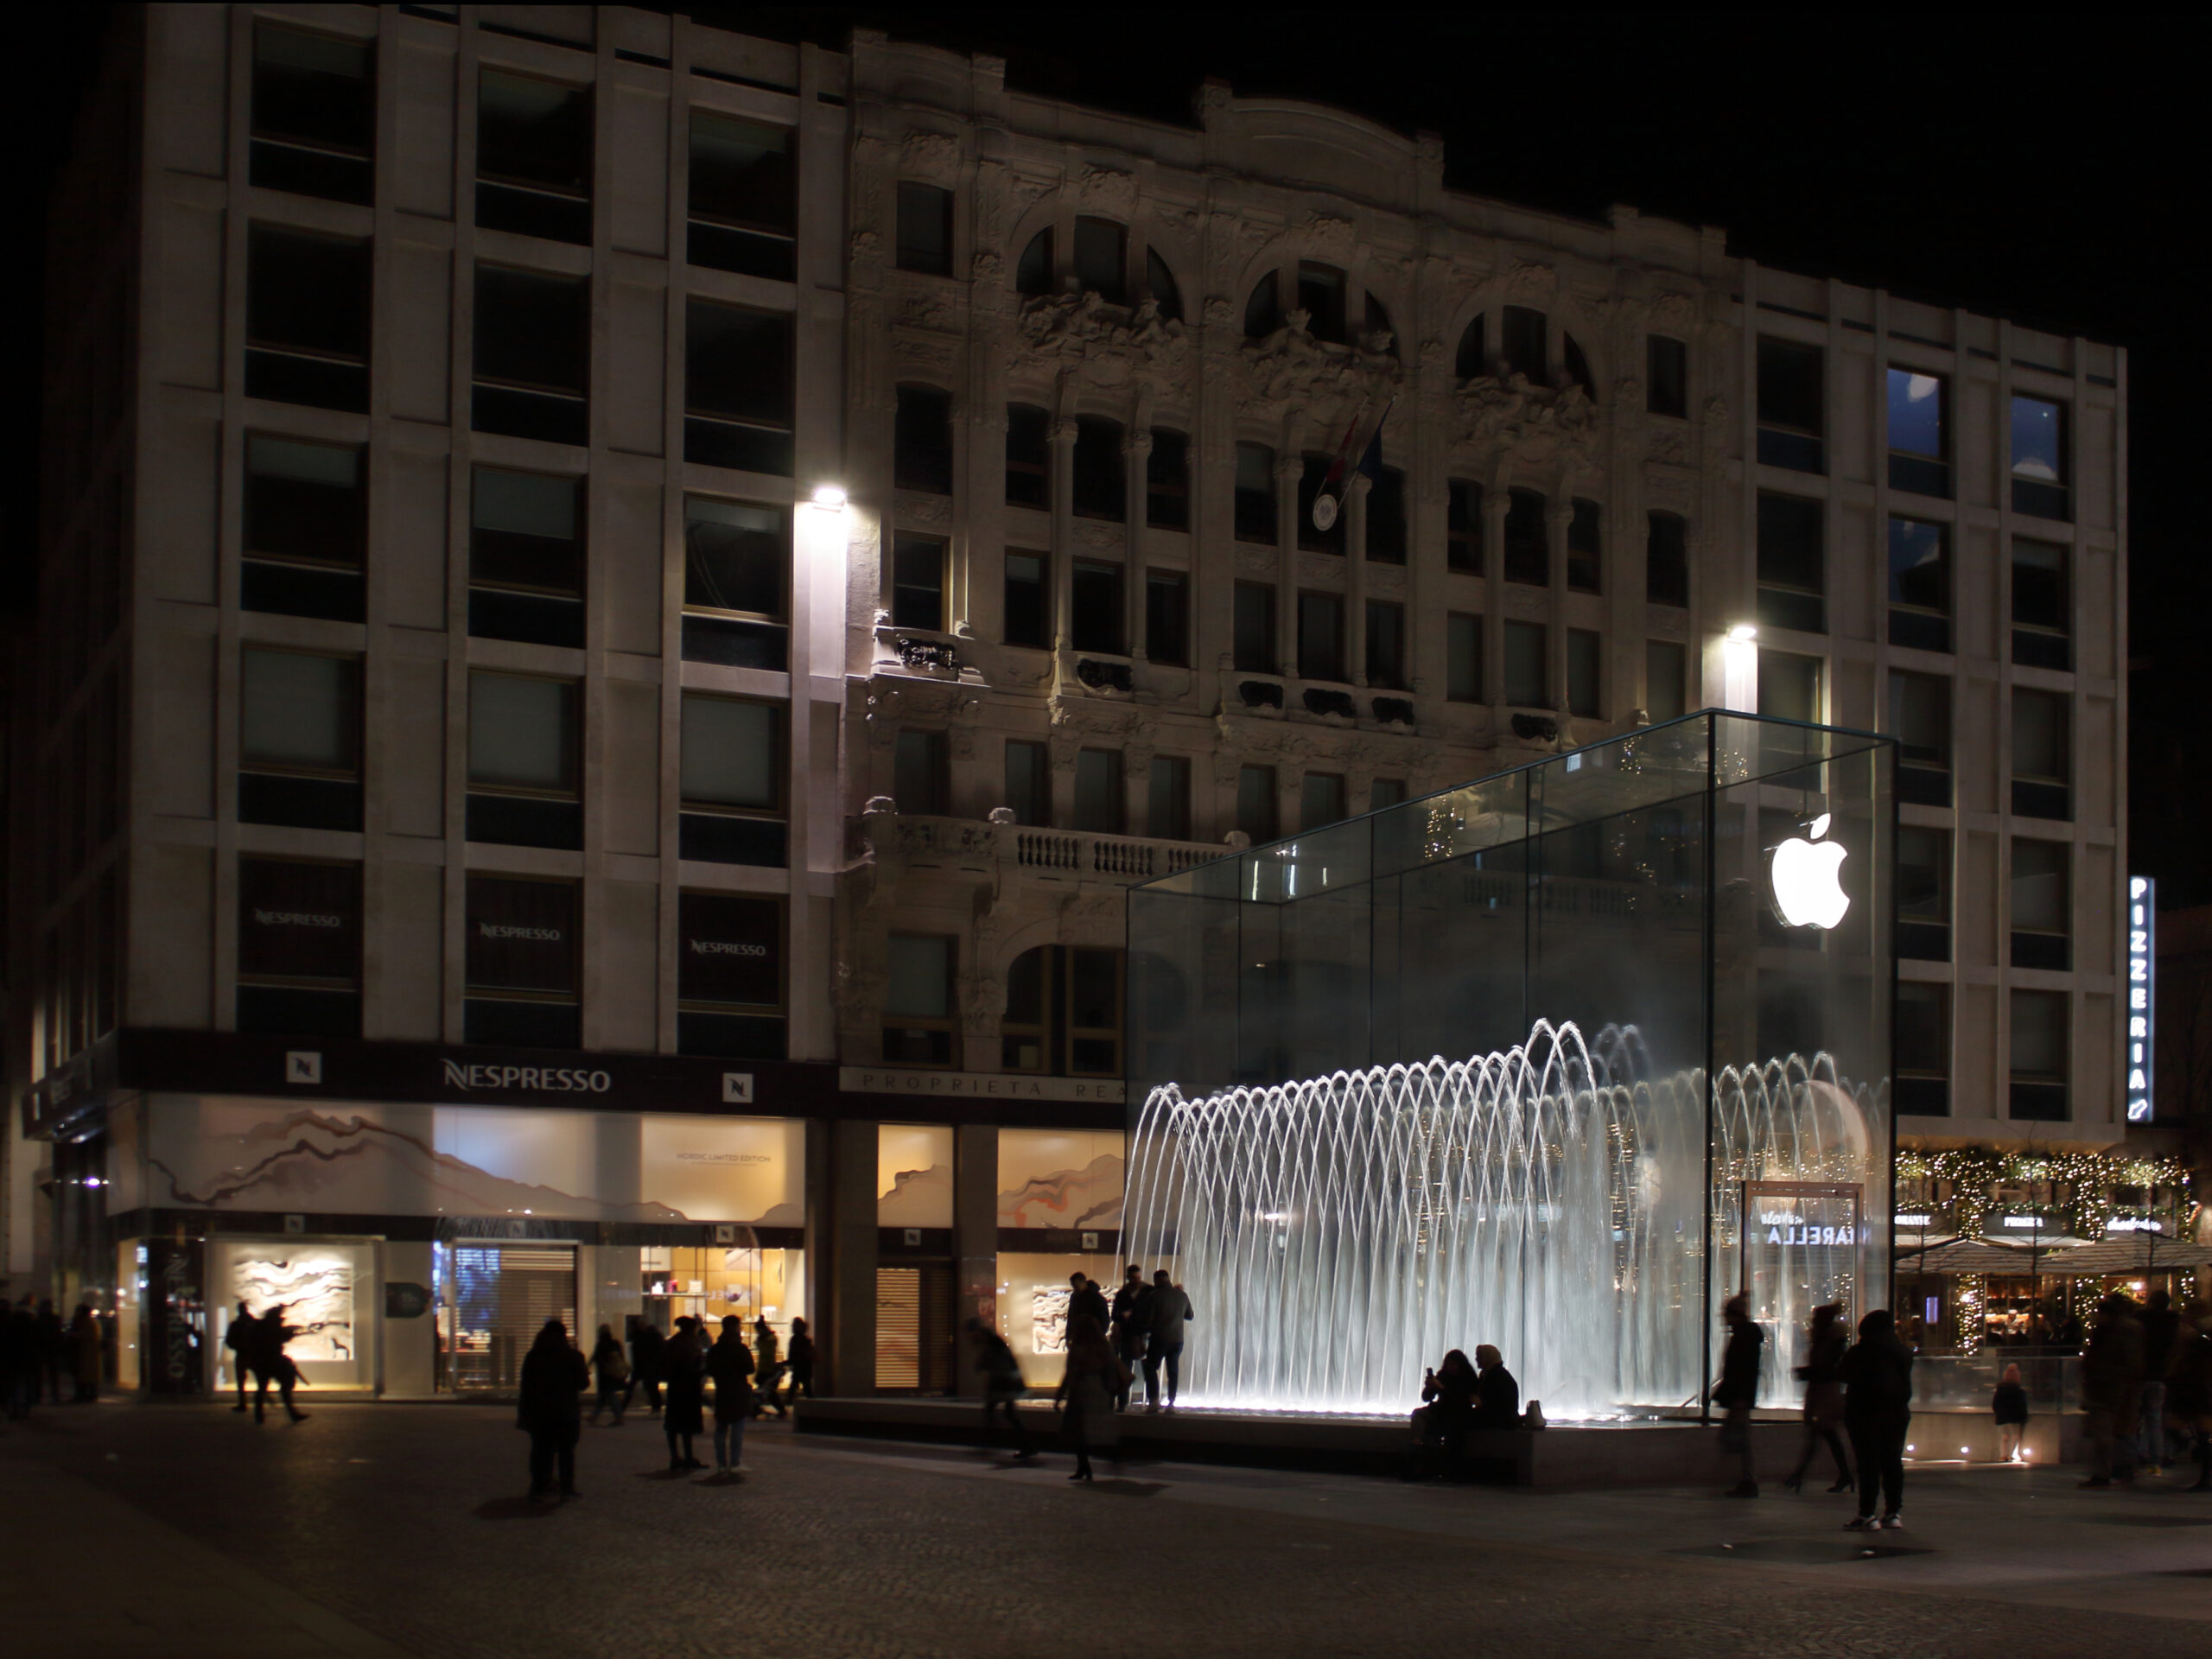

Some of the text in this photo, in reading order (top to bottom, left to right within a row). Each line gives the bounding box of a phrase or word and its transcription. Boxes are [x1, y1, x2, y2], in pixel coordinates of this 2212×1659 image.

[479, 921, 561, 941] NESPRESSO
[689, 938, 767, 957] NESPRESSO
[2129, 878, 2148, 1090] PIZZERIA
[439, 1058, 612, 1093] NESPRESSO
[162, 1255, 190, 1379] NERESSO
